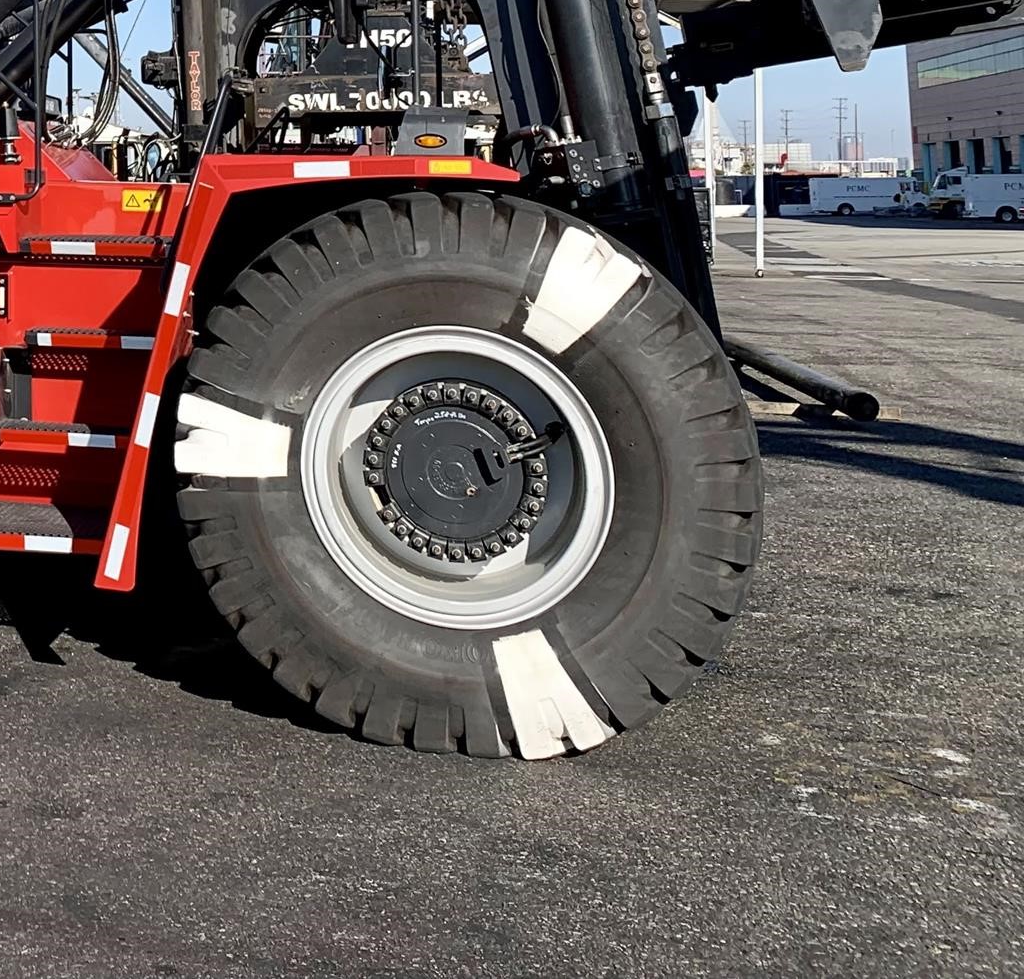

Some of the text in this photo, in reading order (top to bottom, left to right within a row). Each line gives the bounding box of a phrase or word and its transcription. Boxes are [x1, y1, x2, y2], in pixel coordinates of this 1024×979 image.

[346, 28, 413, 49] H50
[188, 51, 202, 111] TAYLOR
[288, 92, 346, 111] SWL
